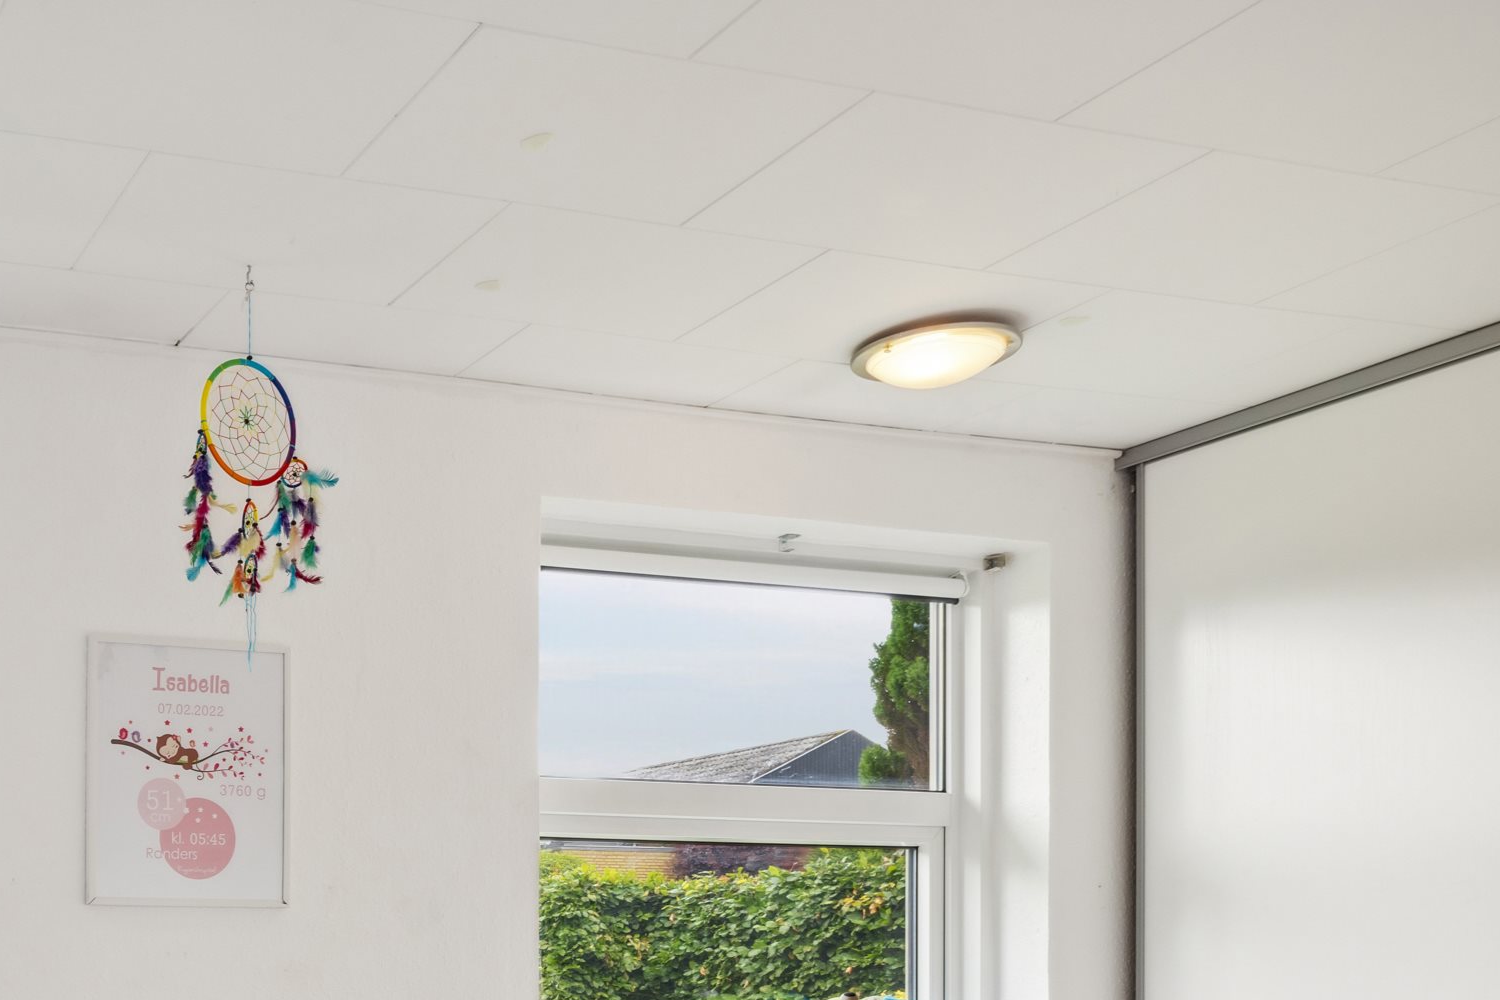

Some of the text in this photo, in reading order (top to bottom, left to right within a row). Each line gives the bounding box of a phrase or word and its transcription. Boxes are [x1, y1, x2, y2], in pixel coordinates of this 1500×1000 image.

[152, 666, 231, 695] Isabella
[157, 703, 225, 718] 07.02.2022
[146, 790, 175, 811] 51
[219, 784, 266, 801] 3760 g
[171, 832, 226, 846] kl. 05:45
[146, 848, 198, 860] Randers
